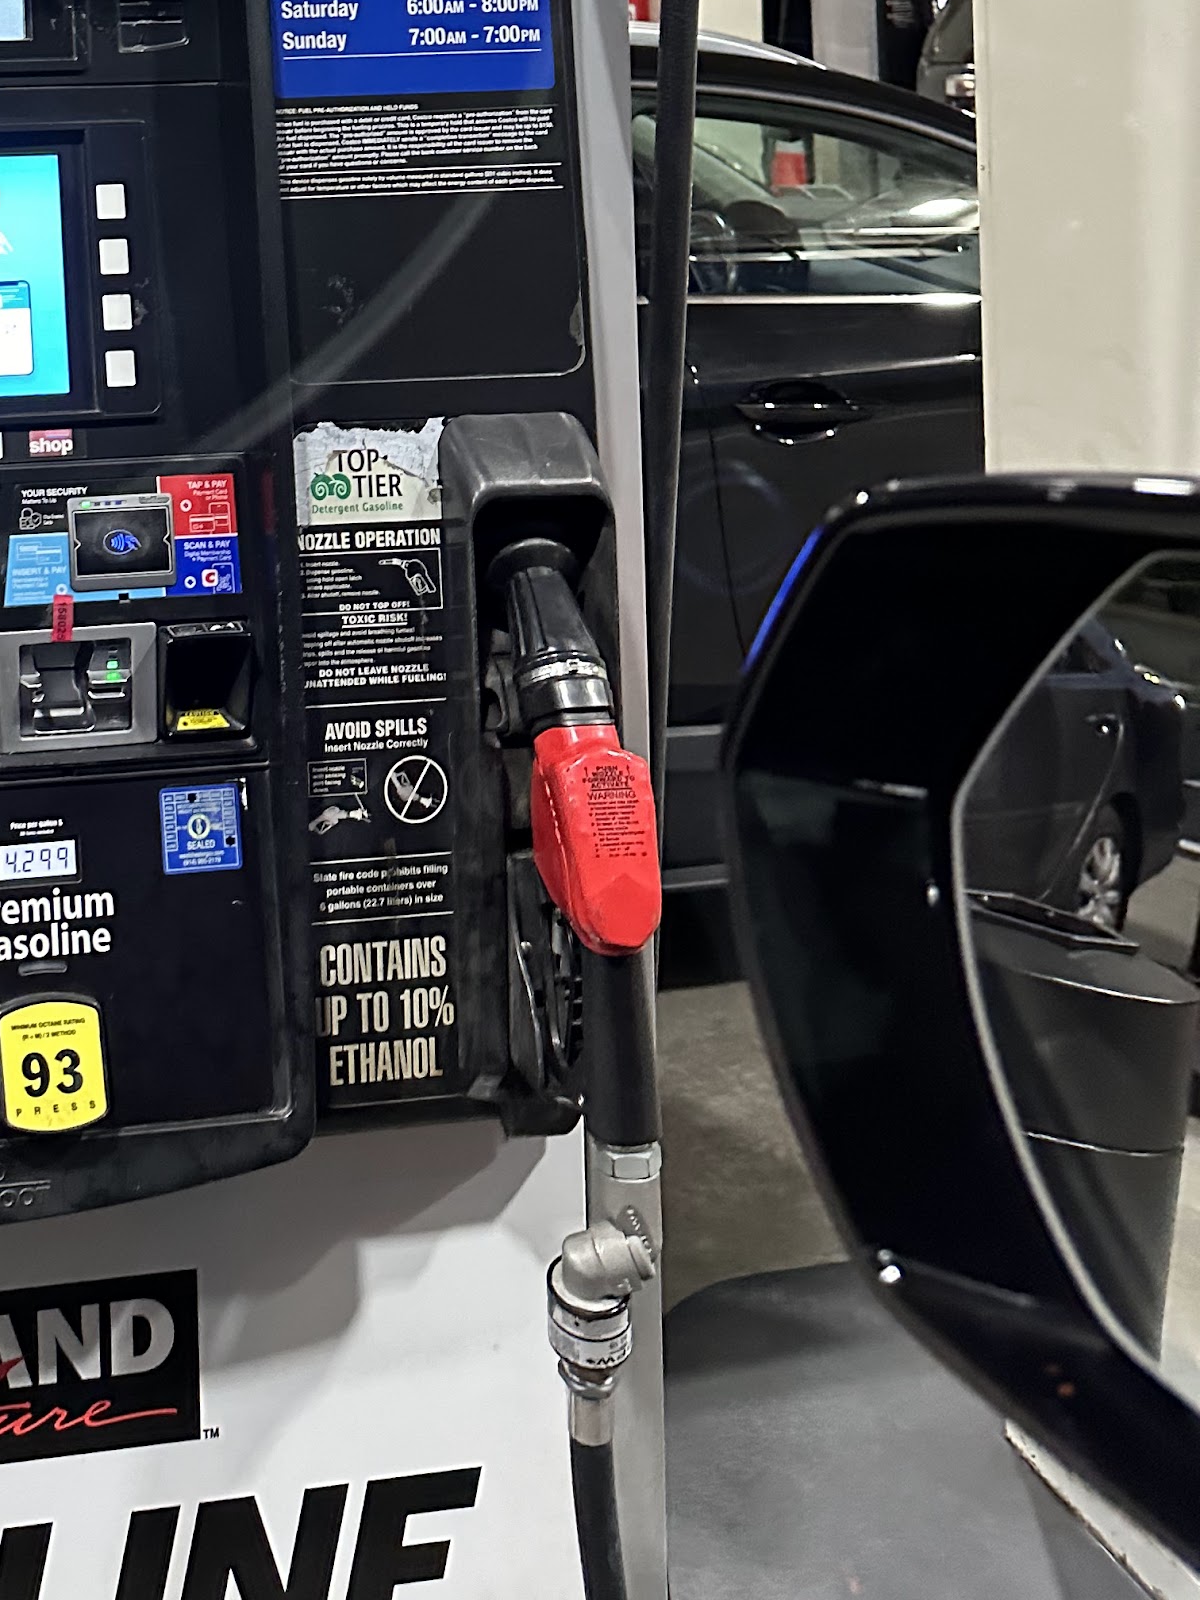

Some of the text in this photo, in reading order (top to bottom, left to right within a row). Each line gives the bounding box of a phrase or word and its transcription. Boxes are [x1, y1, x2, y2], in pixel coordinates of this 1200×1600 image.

[281, 1, 358, 20] Saturday
[283, 26, 540, 51] Sunday 7:00AM 7:00PM
[29, 438, 73, 456] shop
[333, 449, 379, 472] TOP
[22, 486, 88, 498] YOUR SECURITY
[352, 474, 403, 497] TIER
[312, 501, 403, 514] Detergent Gasoline
[298, 528, 440, 550] NOZZLE OPERATION
[342, 613, 408, 625] TOXIC RISK!
[335, 668, 355, 677] NOT
[358, 666, 388, 675] LEAVE
[391, 664, 429, 673] NOZZLE
[369, 676, 399, 685] WHILE
[402, 673, 446, 683] FUELING!
[325, 718, 427, 740] AVOID SPILLS
[325, 738, 428, 753] Insert Nozzle Correctly
[187, 839, 215, 850] SEALED
[6, 847, 67, 873] 4.299
[320, 935, 447, 988] CONTAINS
[315, 985, 455, 1037] UP TO 10%
[329, 1037, 443, 1086] ETHANOL
[22, 1049, 84, 1097] 93
